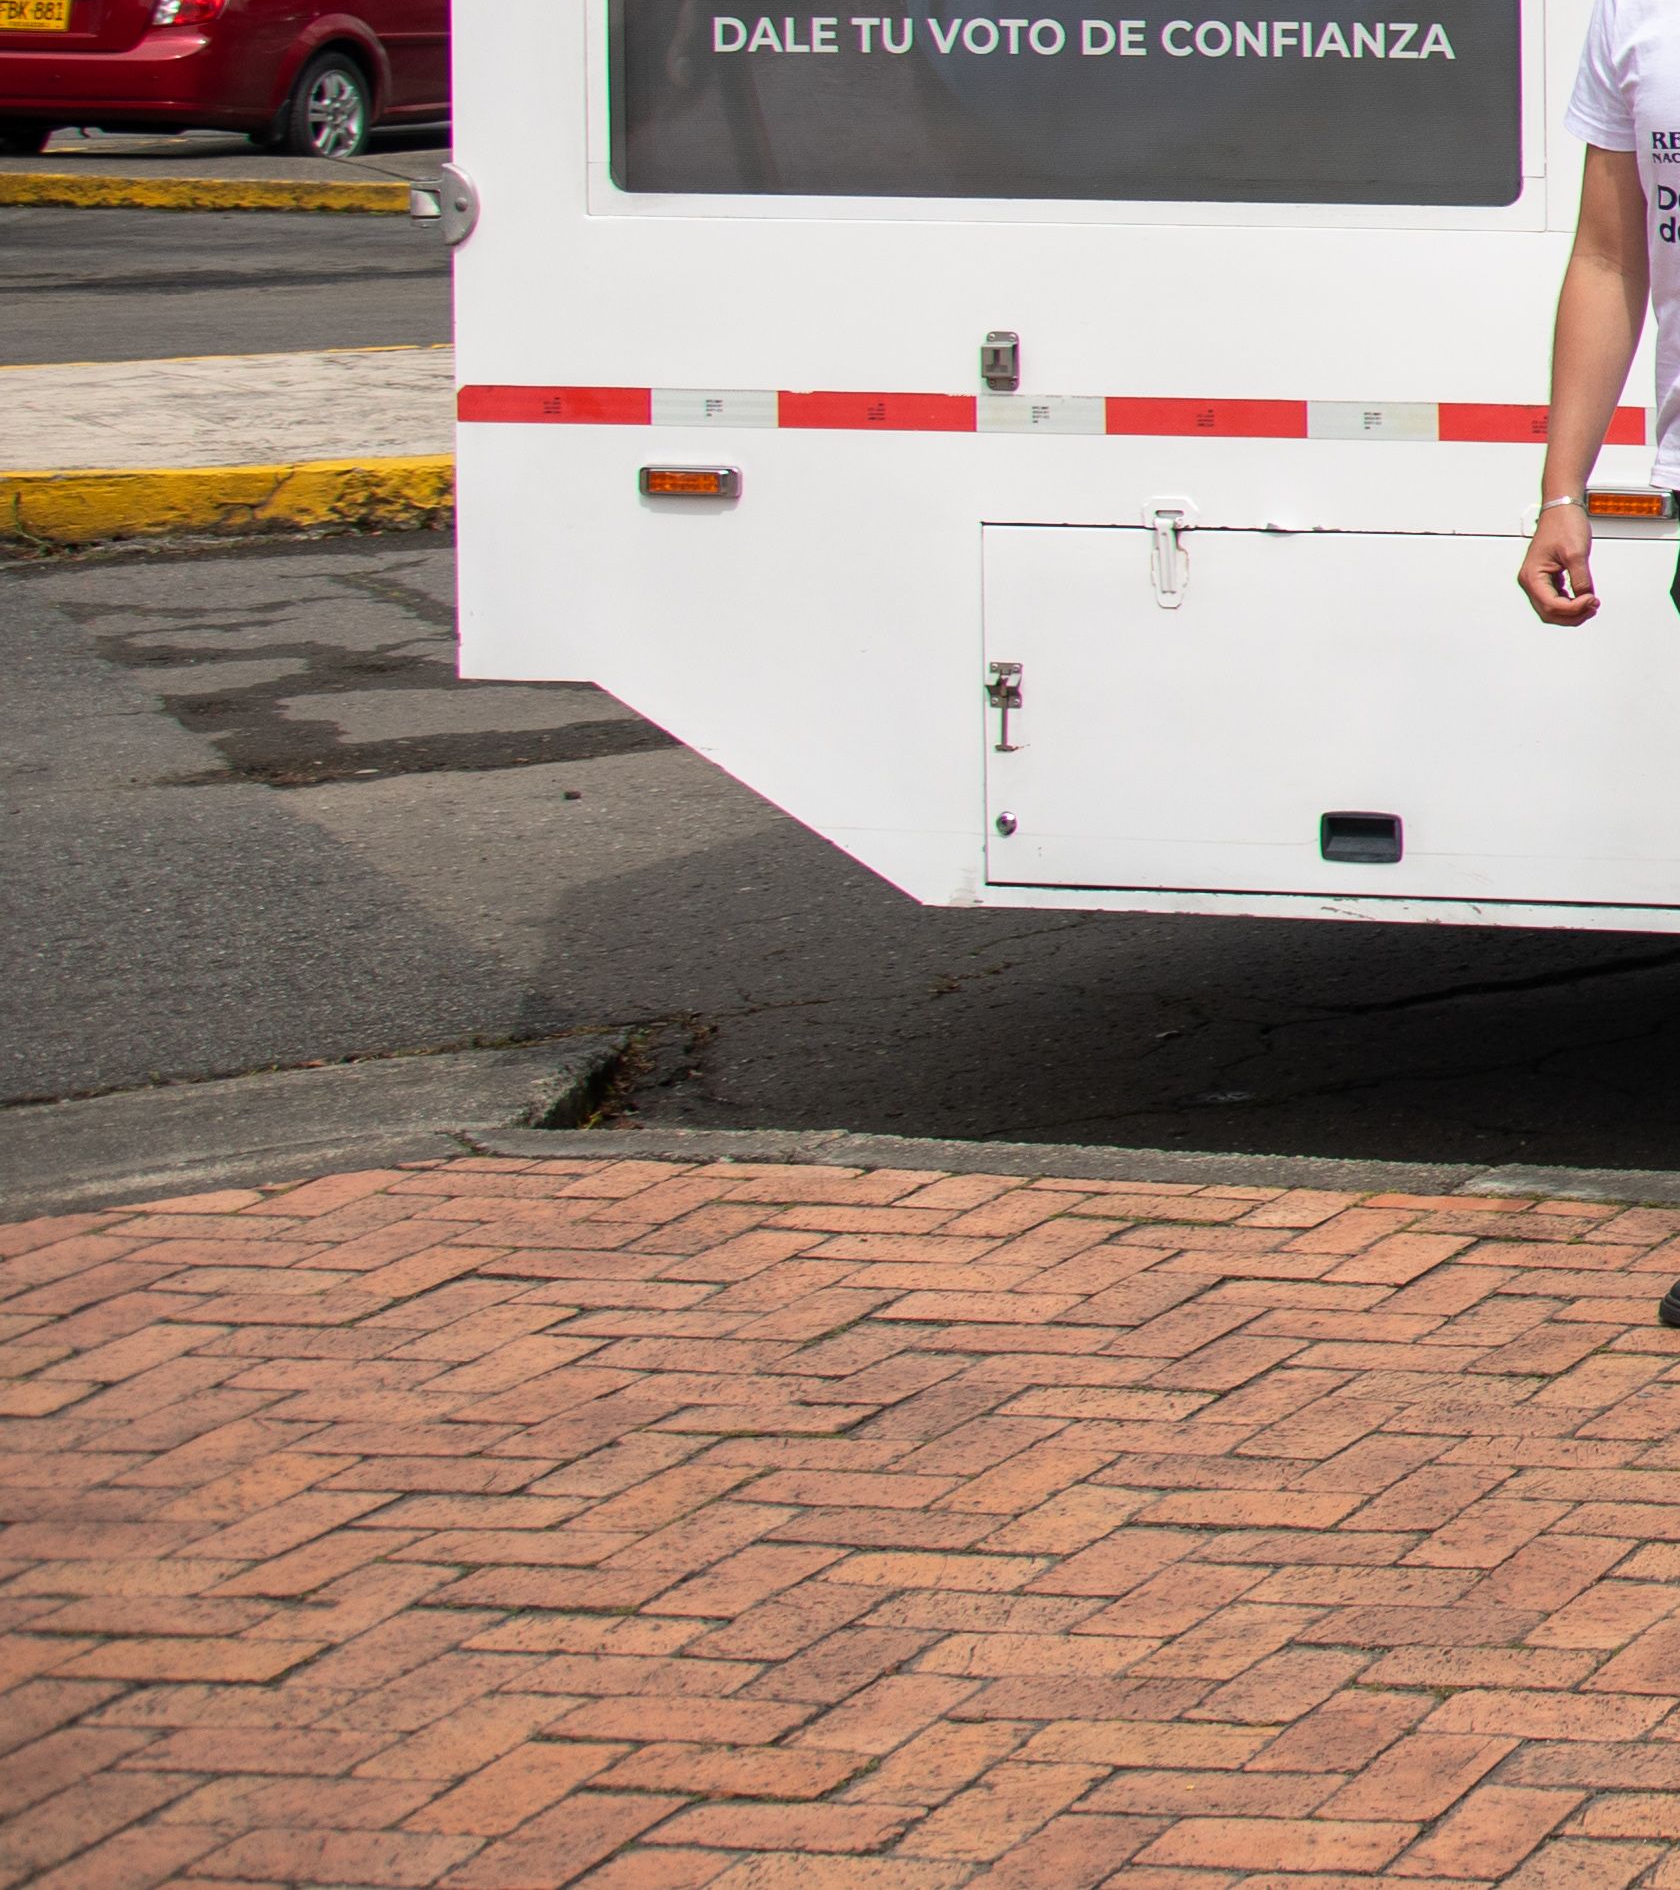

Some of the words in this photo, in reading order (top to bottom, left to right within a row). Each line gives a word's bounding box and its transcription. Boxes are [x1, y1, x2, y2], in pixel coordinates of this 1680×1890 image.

[712, 17, 838, 53] DALE
[851, 17, 914, 54] TU
[928, 18, 1066, 56] VOTO
[1082, 20, 1147, 56] DE
[1162, 20, 1456, 60] CONFIANZA
